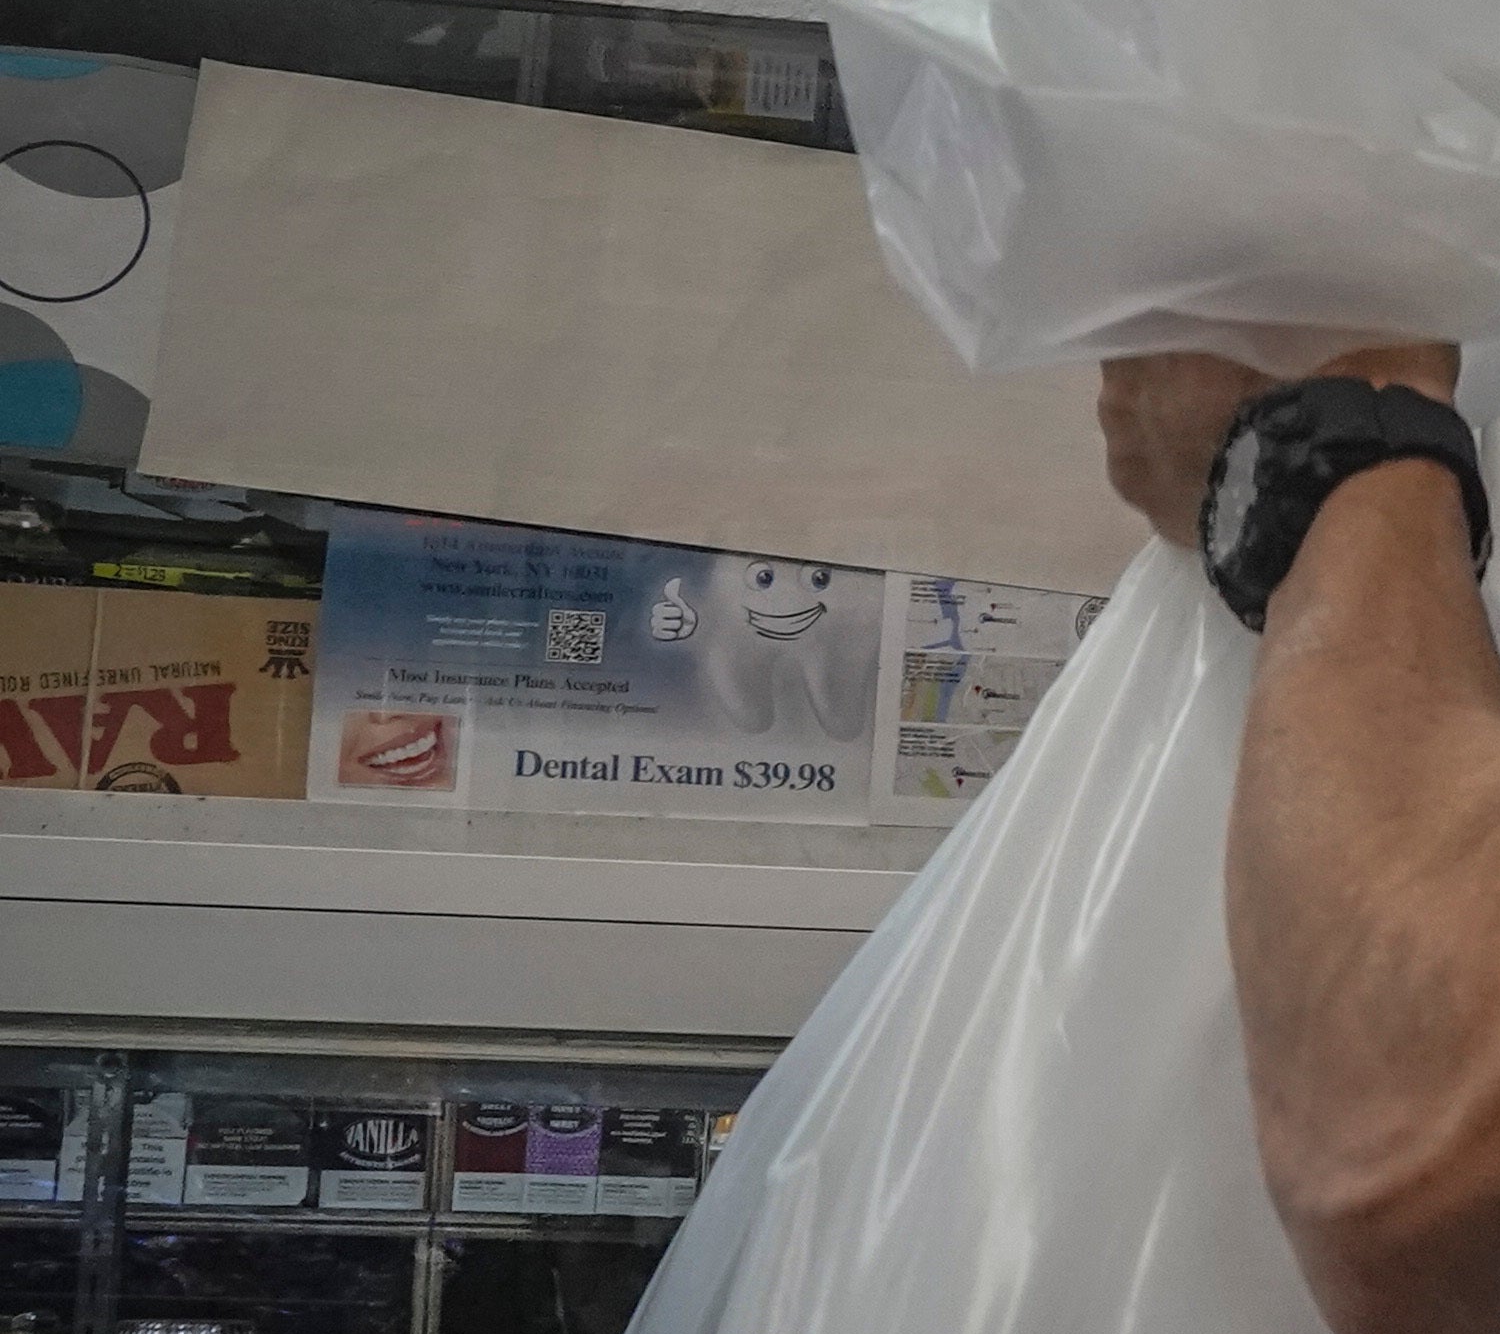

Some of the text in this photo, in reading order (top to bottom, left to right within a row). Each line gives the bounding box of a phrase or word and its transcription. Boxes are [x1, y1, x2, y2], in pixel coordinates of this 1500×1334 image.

[266, 620, 311, 635] SIZE
[265, 633, 310, 648] KING
[153, 660, 222, 683] NATURAL
[387, 667, 631, 695] Most Insurance Plans Accepted
[515, 748, 837, 792] Dental Exam $39.98
